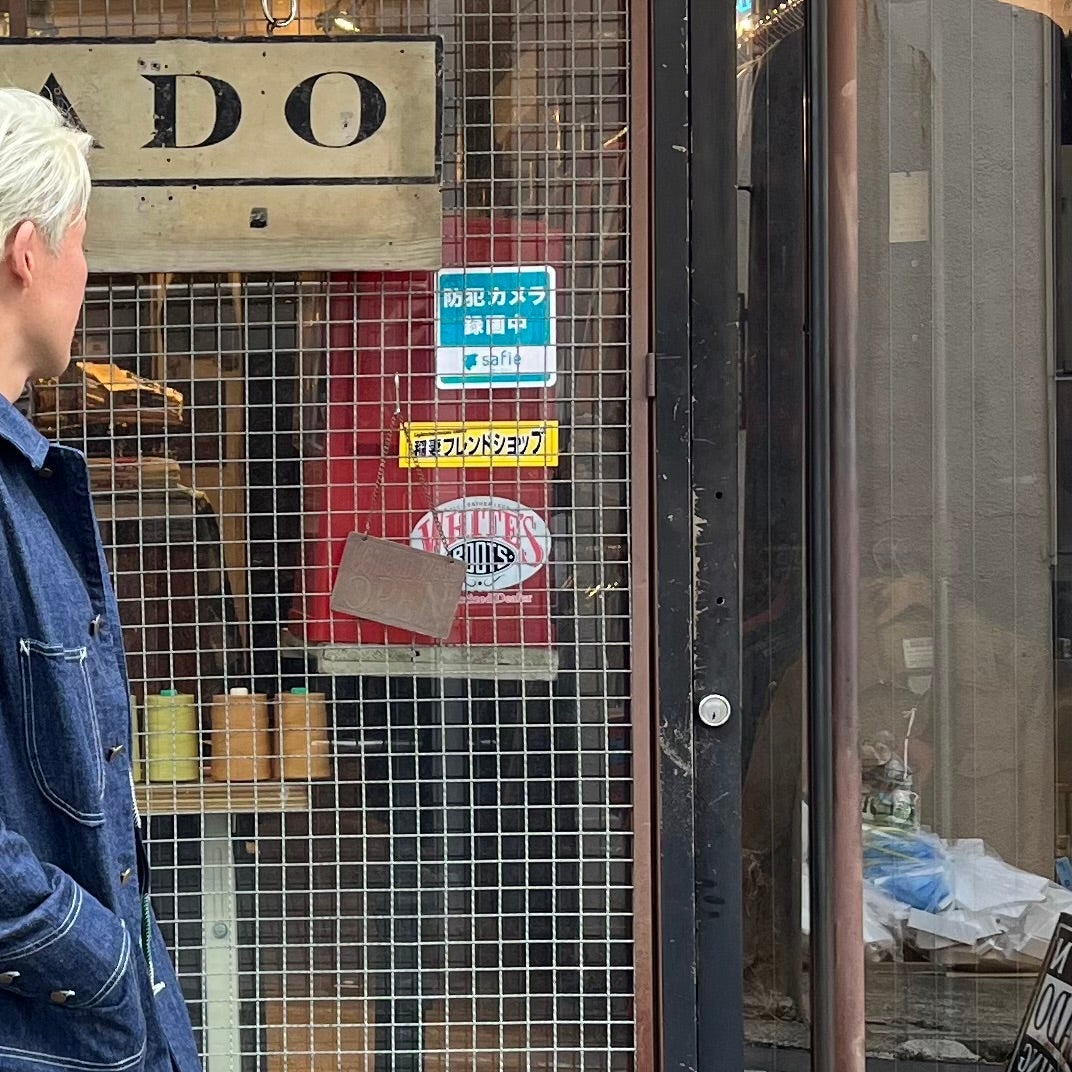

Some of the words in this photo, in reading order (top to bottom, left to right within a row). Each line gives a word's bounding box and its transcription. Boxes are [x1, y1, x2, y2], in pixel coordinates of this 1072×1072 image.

[443, 285, 546, 308] 防犯カメラ
[464, 314, 527, 335] 録画中
[482, 350, 522, 367] safie
